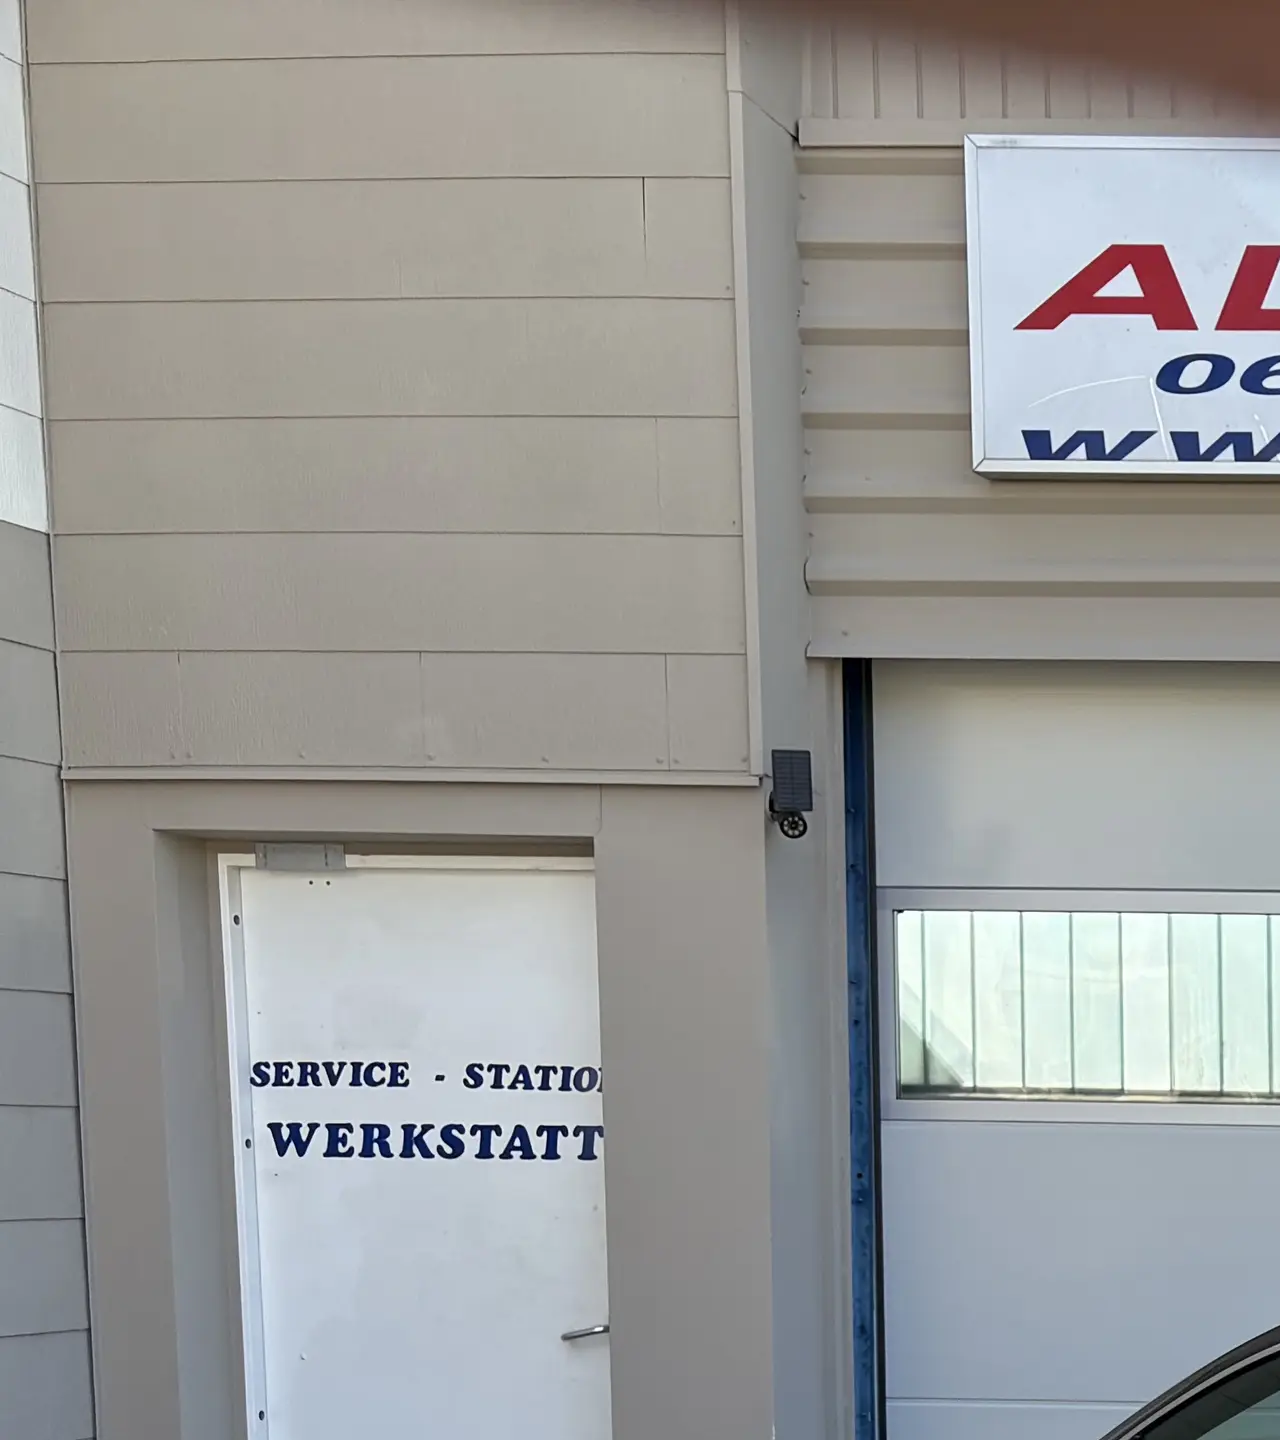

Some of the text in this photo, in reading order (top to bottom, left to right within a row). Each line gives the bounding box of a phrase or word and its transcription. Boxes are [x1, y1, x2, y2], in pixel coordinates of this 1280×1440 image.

[250, 1061, 410, 1088] SERVICE
[462, 1063, 602, 1093] STATIO
[266, 1122, 604, 1161] WERKSTATT
